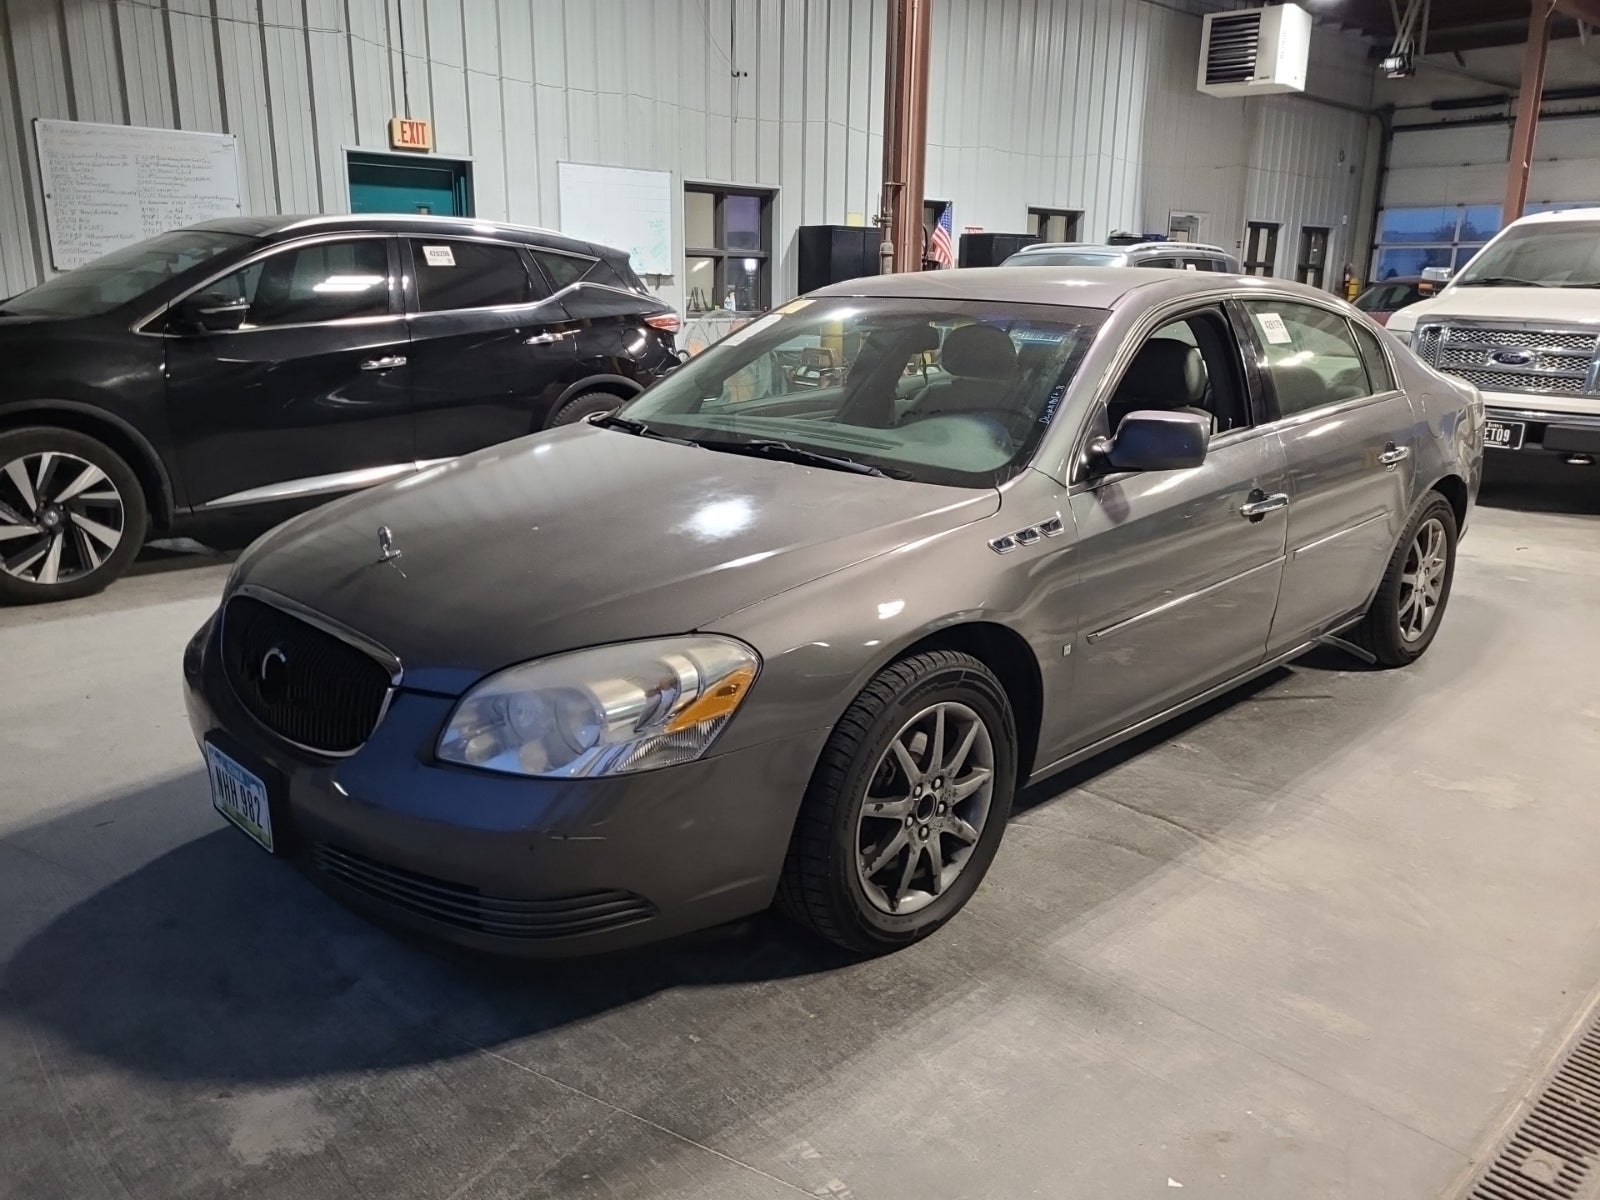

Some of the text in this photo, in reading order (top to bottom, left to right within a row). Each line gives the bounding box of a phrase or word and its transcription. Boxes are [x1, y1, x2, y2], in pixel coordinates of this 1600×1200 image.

[401, 121, 426, 145] EXIT
[216, 766, 238, 809] NHH
[240, 784, 263, 829] 982
